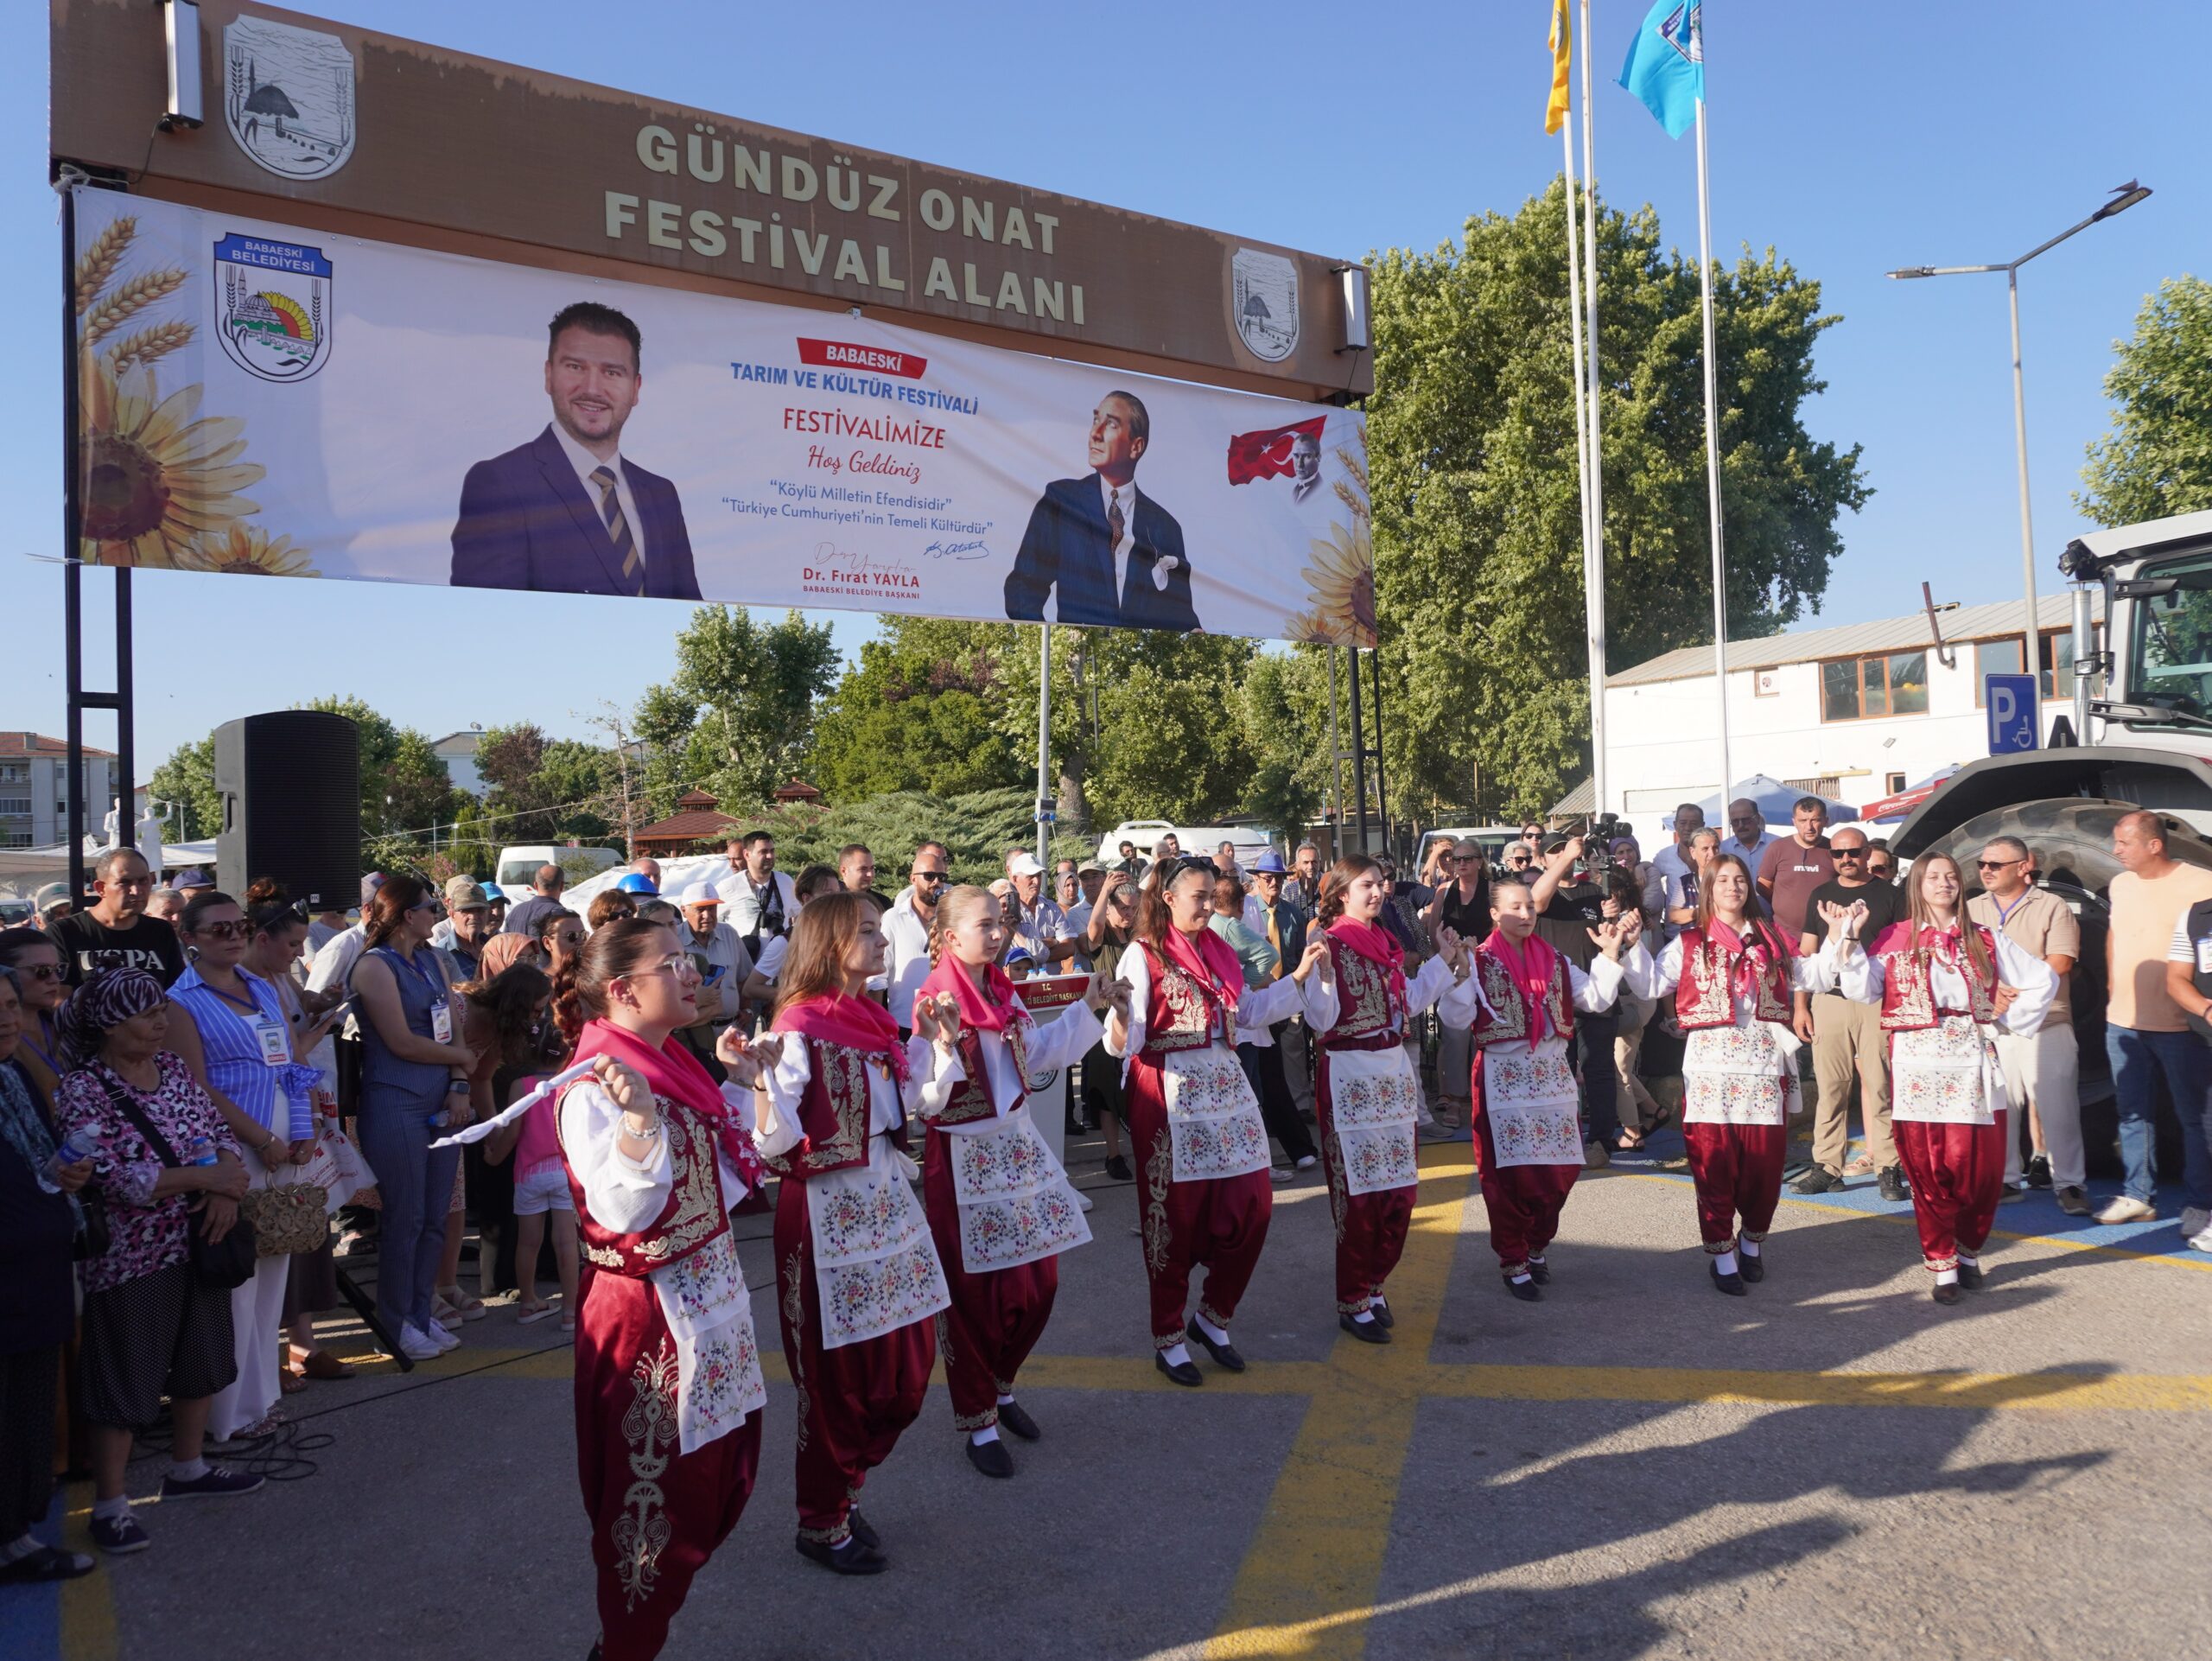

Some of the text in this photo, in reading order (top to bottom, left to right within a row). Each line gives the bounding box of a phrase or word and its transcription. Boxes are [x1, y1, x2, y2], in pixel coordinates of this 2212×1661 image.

[637, 123, 1059, 255] GÜNDÜZ ONAT
[232, 249, 315, 272] BELEDİYESİ
[245, 241, 302, 258] BABAESKİ
[605, 190, 1085, 325] FESTİVAL ALANI
[826, 345, 903, 372] BABAESKİ
[730, 361, 979, 416] TARIM VE KÜLTÜR FESTİVALİ
[784, 407, 946, 449] FESTİVALİMİZE
[808, 444, 921, 485] Hoş Geldiniz
[821, 486, 872, 504] Milletin
[887, 513, 927, 530] Temeli
[803, 567, 920, 589] Dr. Fırat YAYLA
[803, 585, 920, 600] BABAESKİ BELEDİYE BAŞKANI
[1991, 686, 2016, 744] P
[1793, 864, 1820, 873] mavi
[1033, 994, 1058, 1004] BELEDİYE
